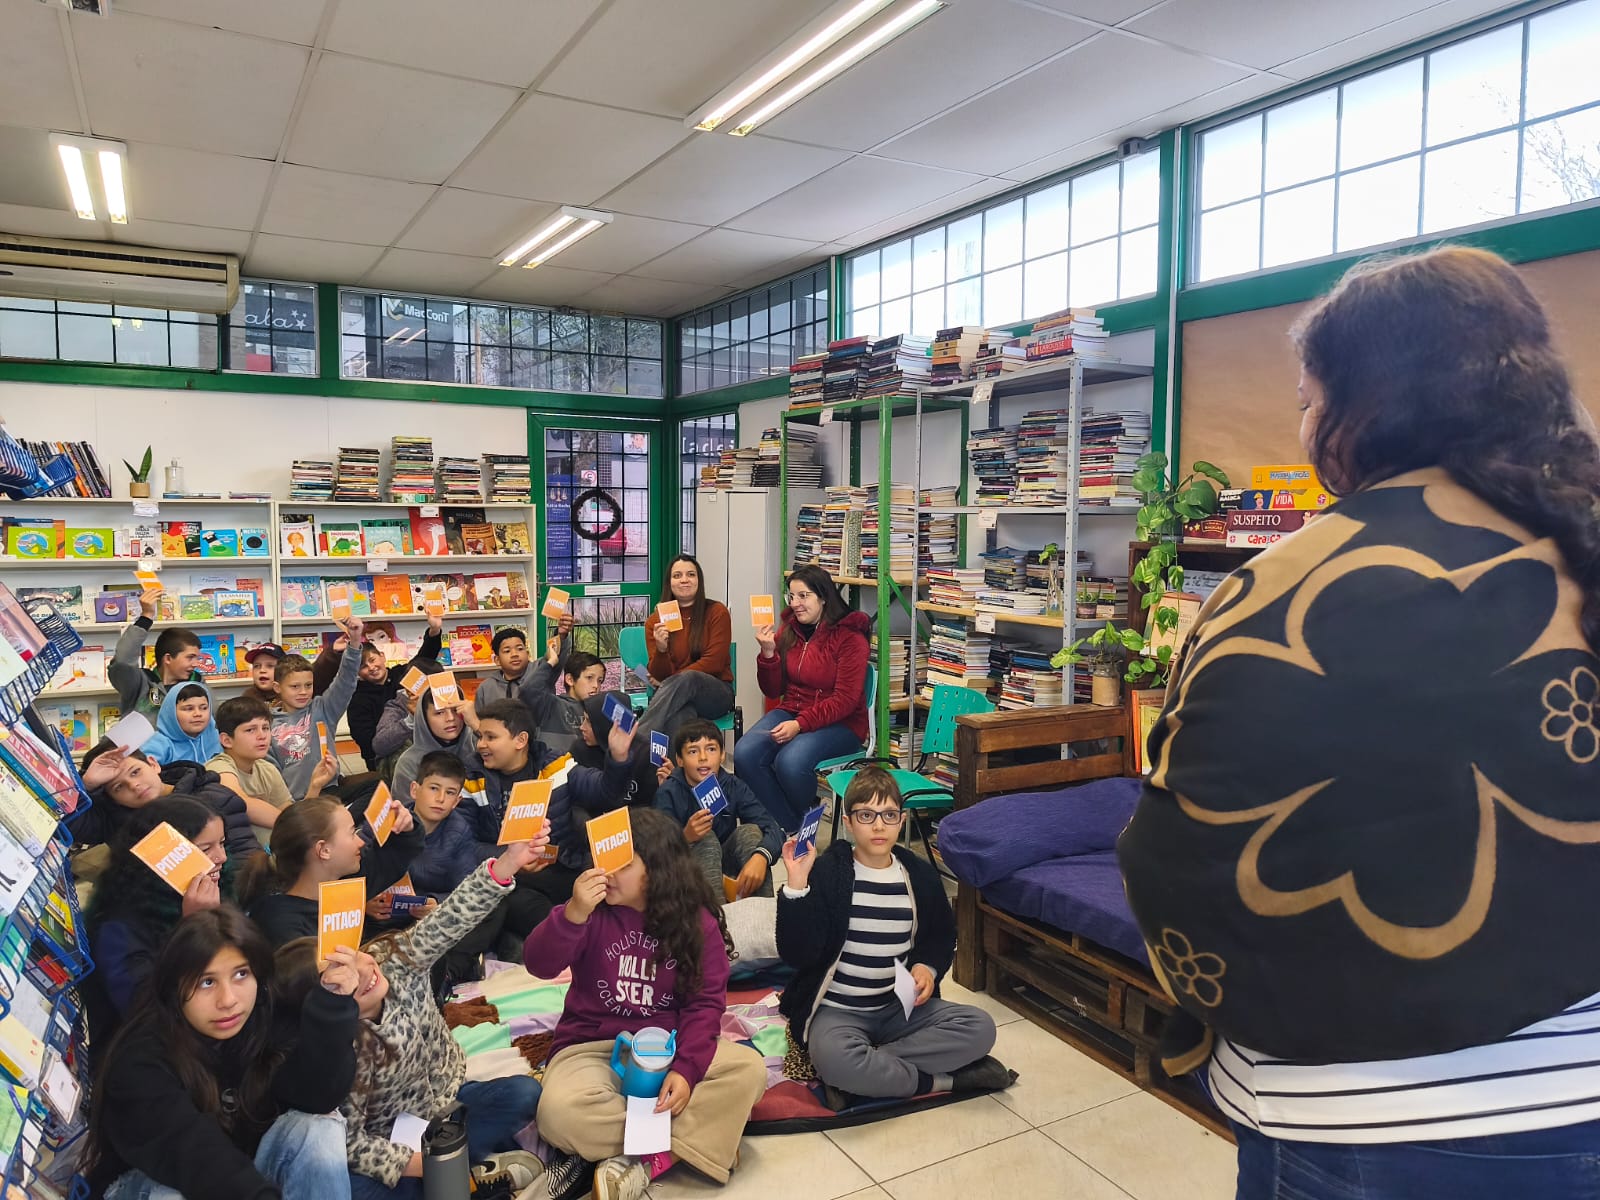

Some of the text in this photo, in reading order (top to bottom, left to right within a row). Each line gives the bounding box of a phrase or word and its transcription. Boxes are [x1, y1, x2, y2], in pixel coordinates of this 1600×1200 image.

[405, 304, 449, 323] MacConT
[1040, 341, 1065, 352] LAROUSSE
[1275, 496, 1293, 504] VIDA
[1233, 514, 1281, 526] SUSPEITO
[652, 743, 667, 758] FATO
[701, 786, 721, 810] FATO
[509, 803, 545, 820] PITACO
[799, 821, 819, 842] FATO
[595, 830, 629, 855] PITACO
[155, 842, 193, 876] PITACO
[323, 909, 361, 933] PITACO
[597, 980, 632, 1016] OCEAN
[615, 980, 654, 1006] STER
